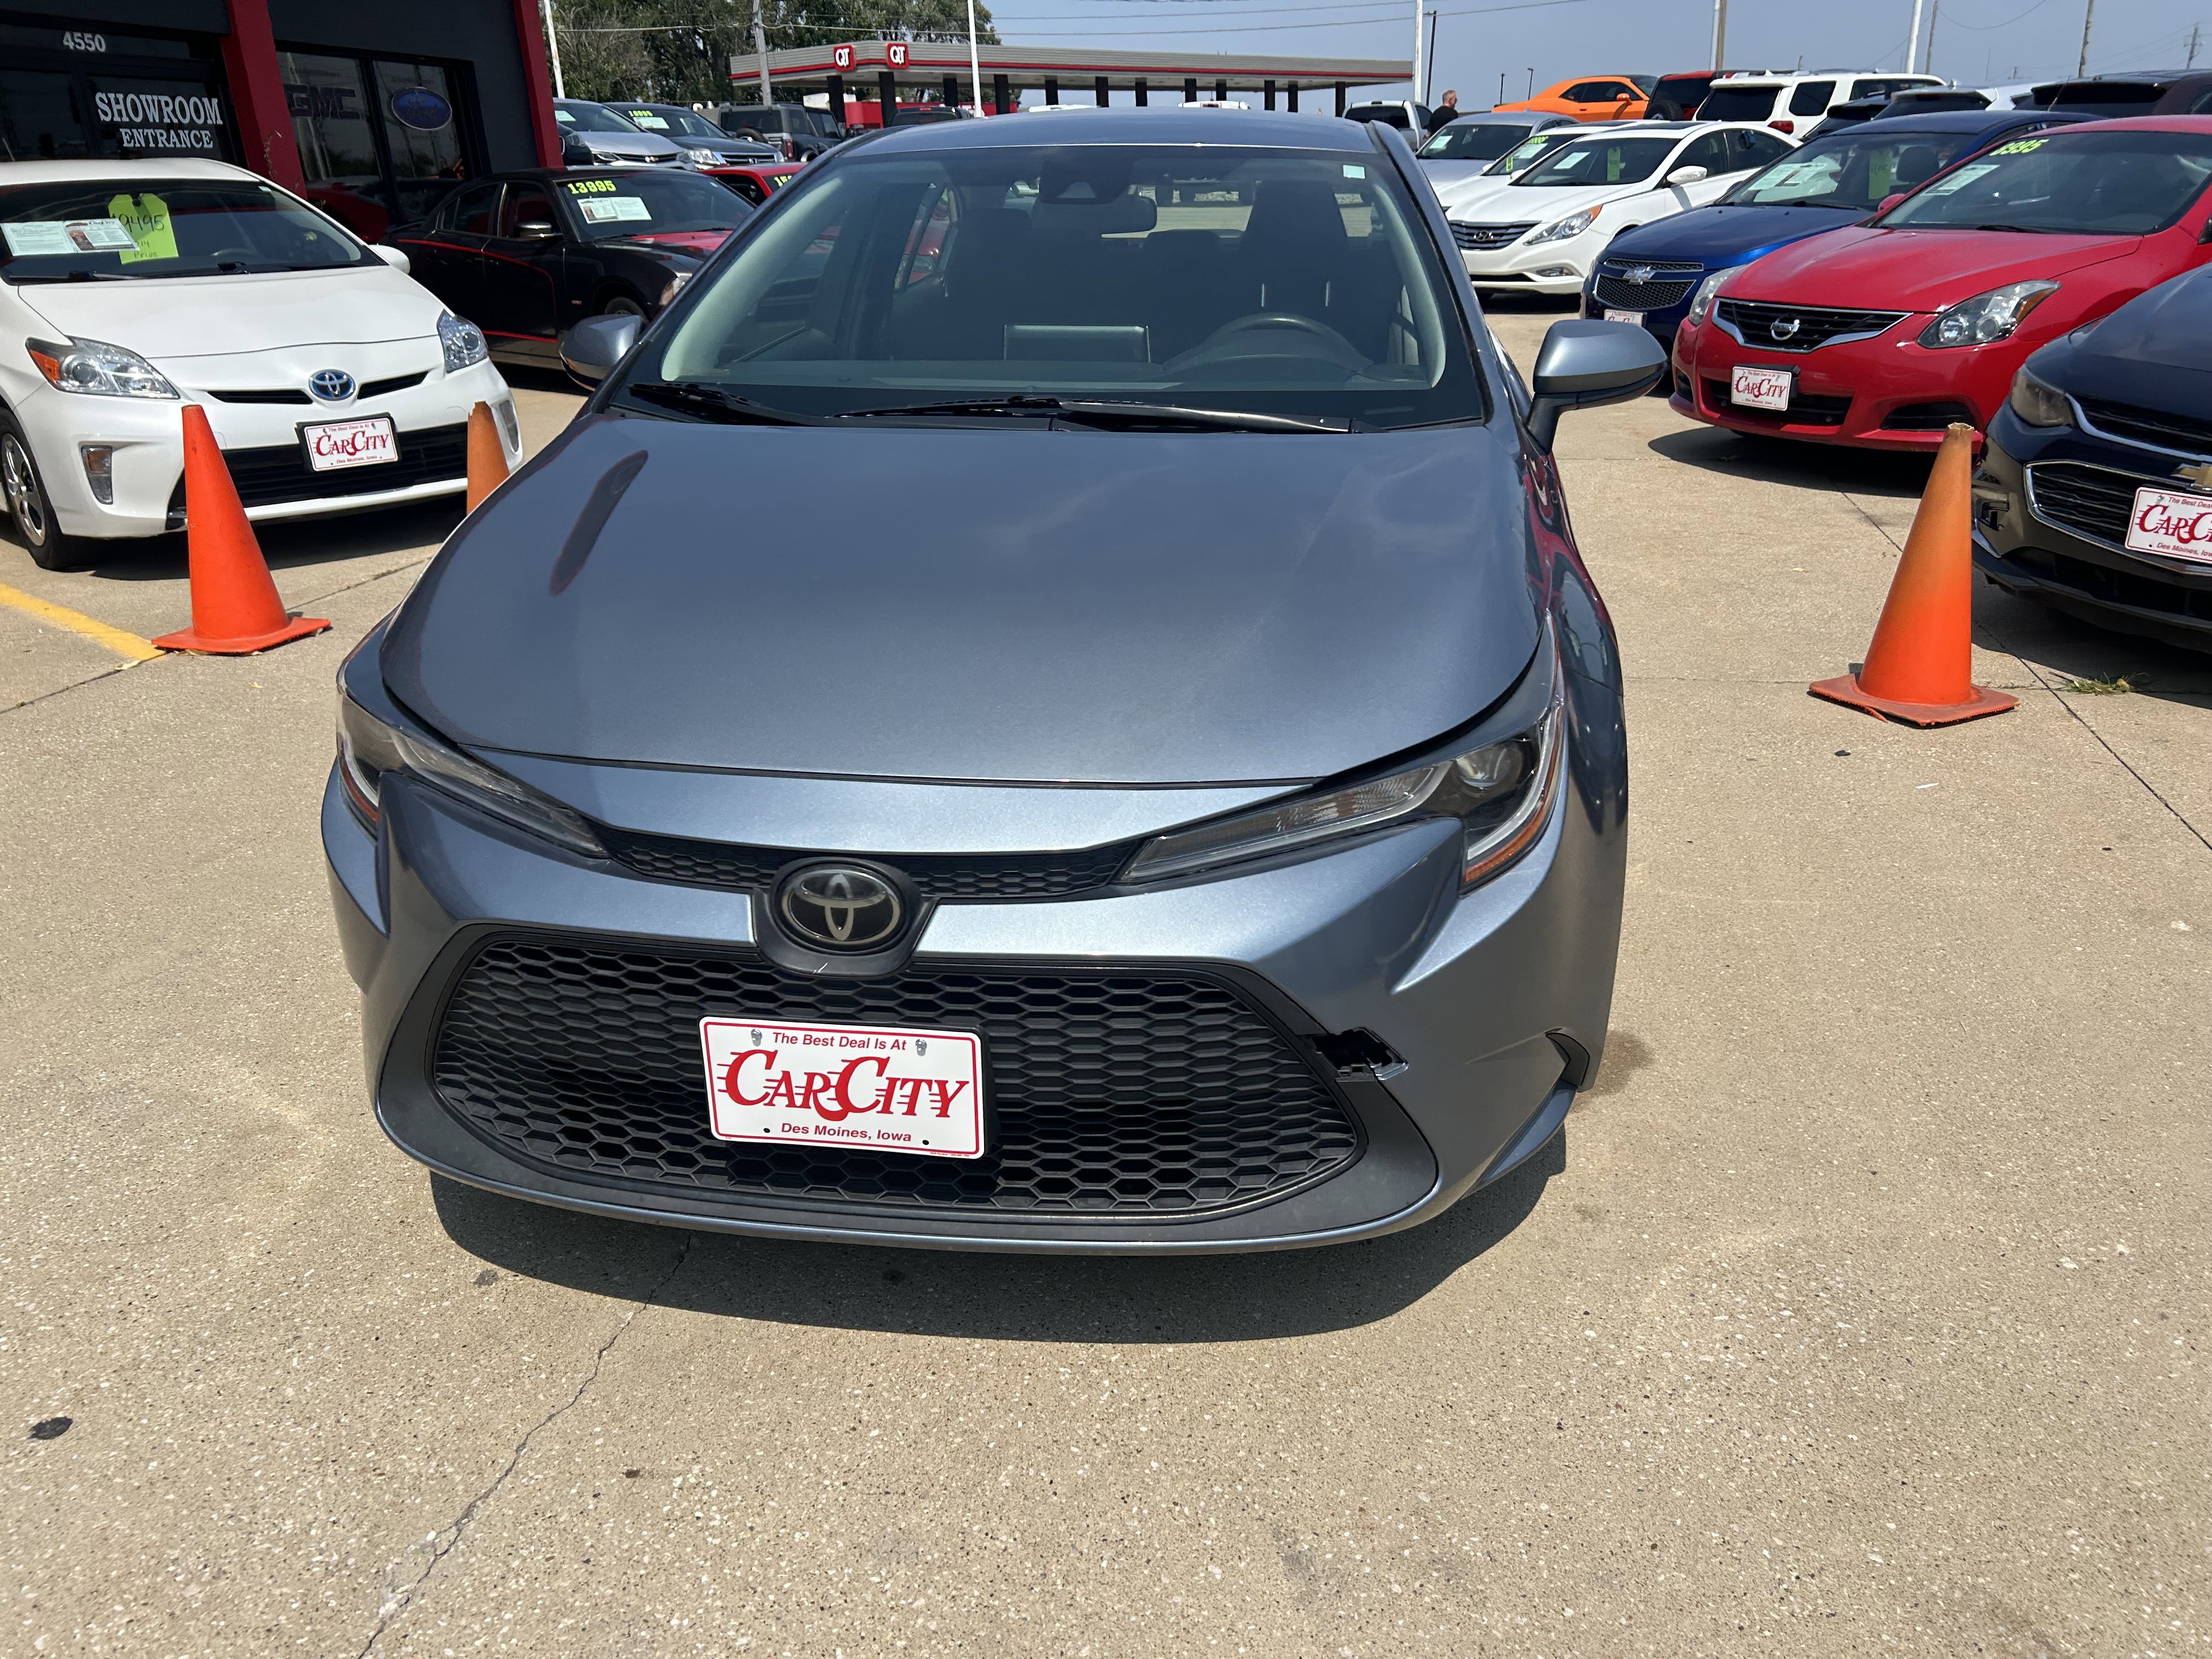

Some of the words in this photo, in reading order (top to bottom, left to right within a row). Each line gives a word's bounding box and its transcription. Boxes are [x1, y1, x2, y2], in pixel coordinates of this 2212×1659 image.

[63, 31, 106, 53] 4550
[835, 48, 850, 67] QT
[890, 46, 905, 65] QT
[95, 92, 223, 125] SHOWROOM
[284, 83, 360, 119] GMC
[119, 128, 213, 148] ENTRANCE
[567, 180, 617, 195] 13995
[111, 213, 164, 233] 9495
[2172, 545, 2199, 555] Moines,
[772, 1032, 799, 1045] The
[803, 1034, 834, 1047] Best
[839, 1037, 870, 1049] Deal
[874, 1039, 887, 1050] Is
[890, 1040, 907, 1051] At
[781, 1122, 809, 1135] Des
[814, 1125, 872, 1140] Moines,
[877, 1128, 912, 1142] Iowa
